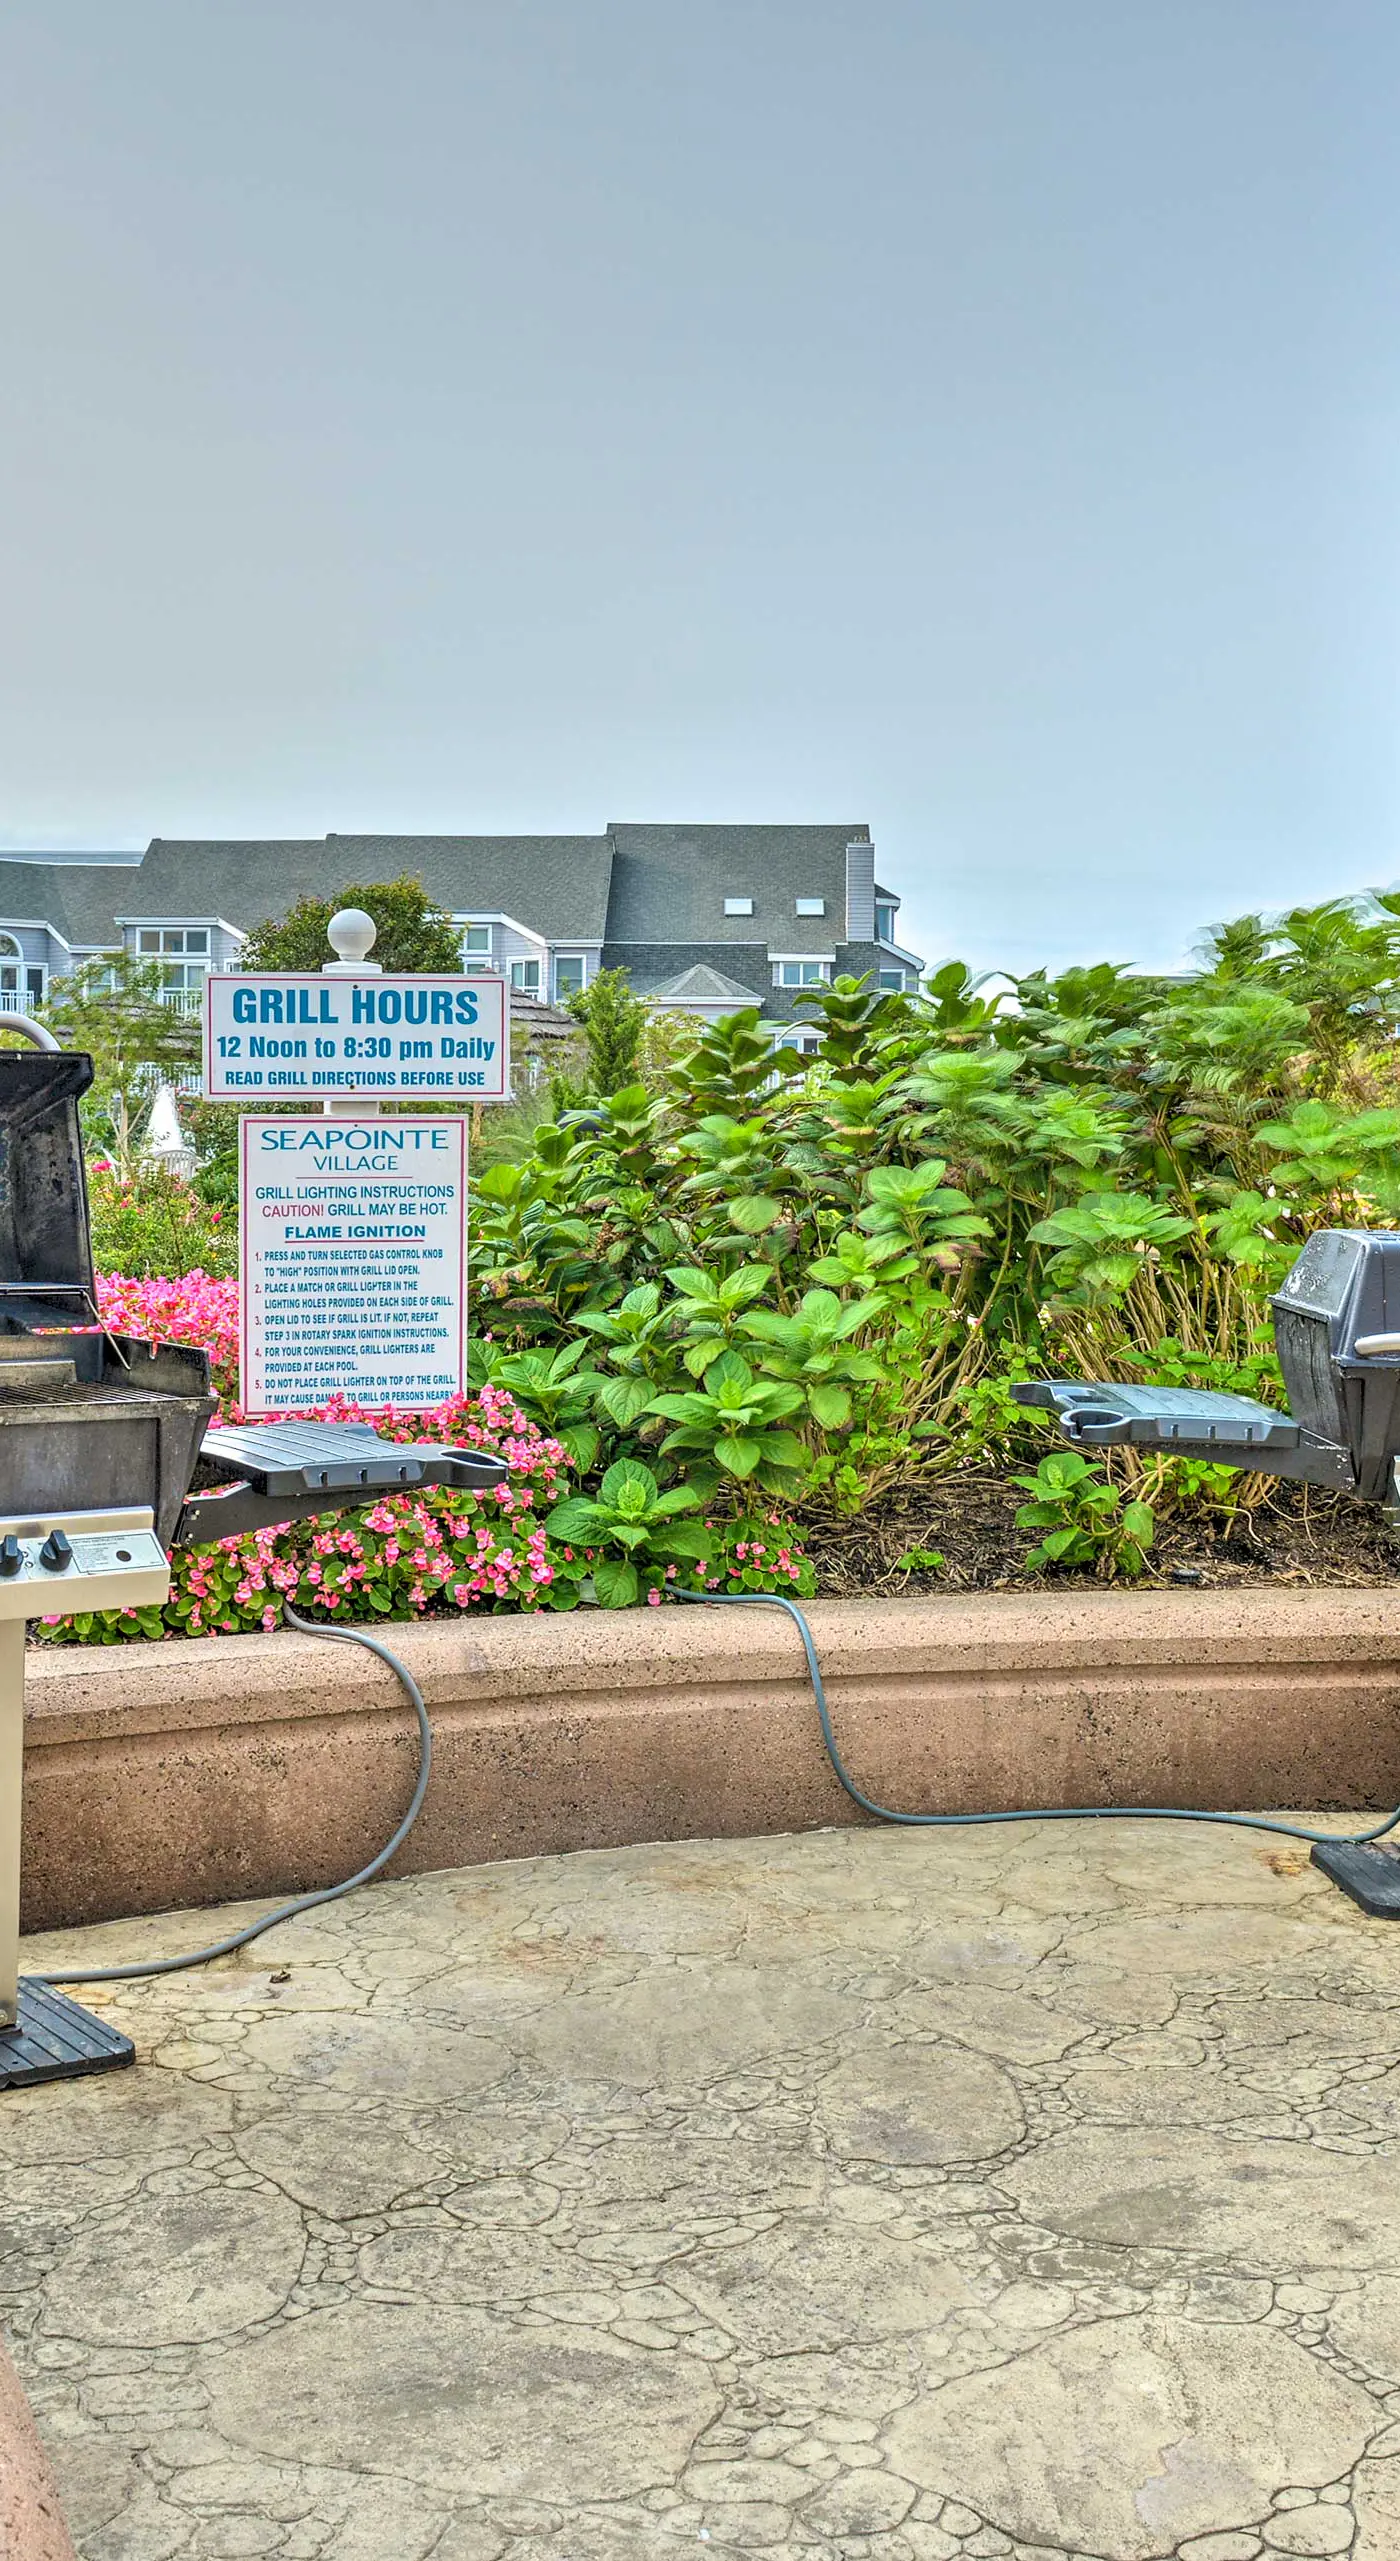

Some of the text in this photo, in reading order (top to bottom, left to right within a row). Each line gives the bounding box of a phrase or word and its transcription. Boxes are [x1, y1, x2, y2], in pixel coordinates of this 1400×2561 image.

[232, 988, 478, 1025] GRILL HOURS
[217, 1036, 495, 1061] 12 Noon to 8:30 pm Daily
[225, 1072, 485, 1085] READ GRILL DIRECTIONS BEFORE USE
[261, 1129, 448, 1150] SEAPOINTE
[313, 1155, 398, 1171] VILLAGE
[256, 1186, 454, 1199] GRILL LIGHTING INSTRUCTIONS
[262, 1203, 447, 1217] CAUTION! GRILL MAY BE HOT.
[285, 1225, 425, 1239] FLAME IGNITION
[255, 1249, 443, 1262] 1. PRESS AND TURN SELECTED GAS CONTROL KNOB
[265, 1265, 419, 1277] TO "HIGH" POSITION WITH GRILL LID OPEN.
[255, 1284, 262, 1293] 2.
[265, 1283, 288, 1293] PLACE
[290, 1283, 296, 1292] A
[298, 1283, 322, 1292] MATCH
[325, 1282, 335, 1292] OR
[337, 1282, 358, 1292] GRILL
[394, 1281, 401, 1291] IN
[403, 1281, 418, 1290] THE
[265, 1297, 454, 1309] LIGHTING HOLES PROVIDED ON EACH SIDE OF GRILL.
[255, 1312, 438, 1325] 3. OPEN LID TO SEE IF GRILL IS LIT. IF NOT, REPEAT
[265, 1328, 449, 1341] STEP 3 IN ROTARY SPARK IGNITION INSTRUCTIONS.
[255, 1344, 435, 1357] 4. FOR YOUR CONVENIENCE, GRILL LIGHTERS ARE
[265, 1362, 358, 1373] PROVIDED AT EACH POOL.
[255, 1375, 456, 1389] 5. DO NOT PLACE GRILL LIGHTER ON TOP OF THE GRILL.
[265, 1395, 272, 1404] IT
[274, 1395, 289, 1404] MAY
[290, 1394, 314, 1404] CAUSE
[347, 1393, 356, 1402] TO
[358, 1393, 378, 1402] GRILL
[380, 1392, 390, 1402] OR
[392, 1391, 424, 1401] PERSONS
